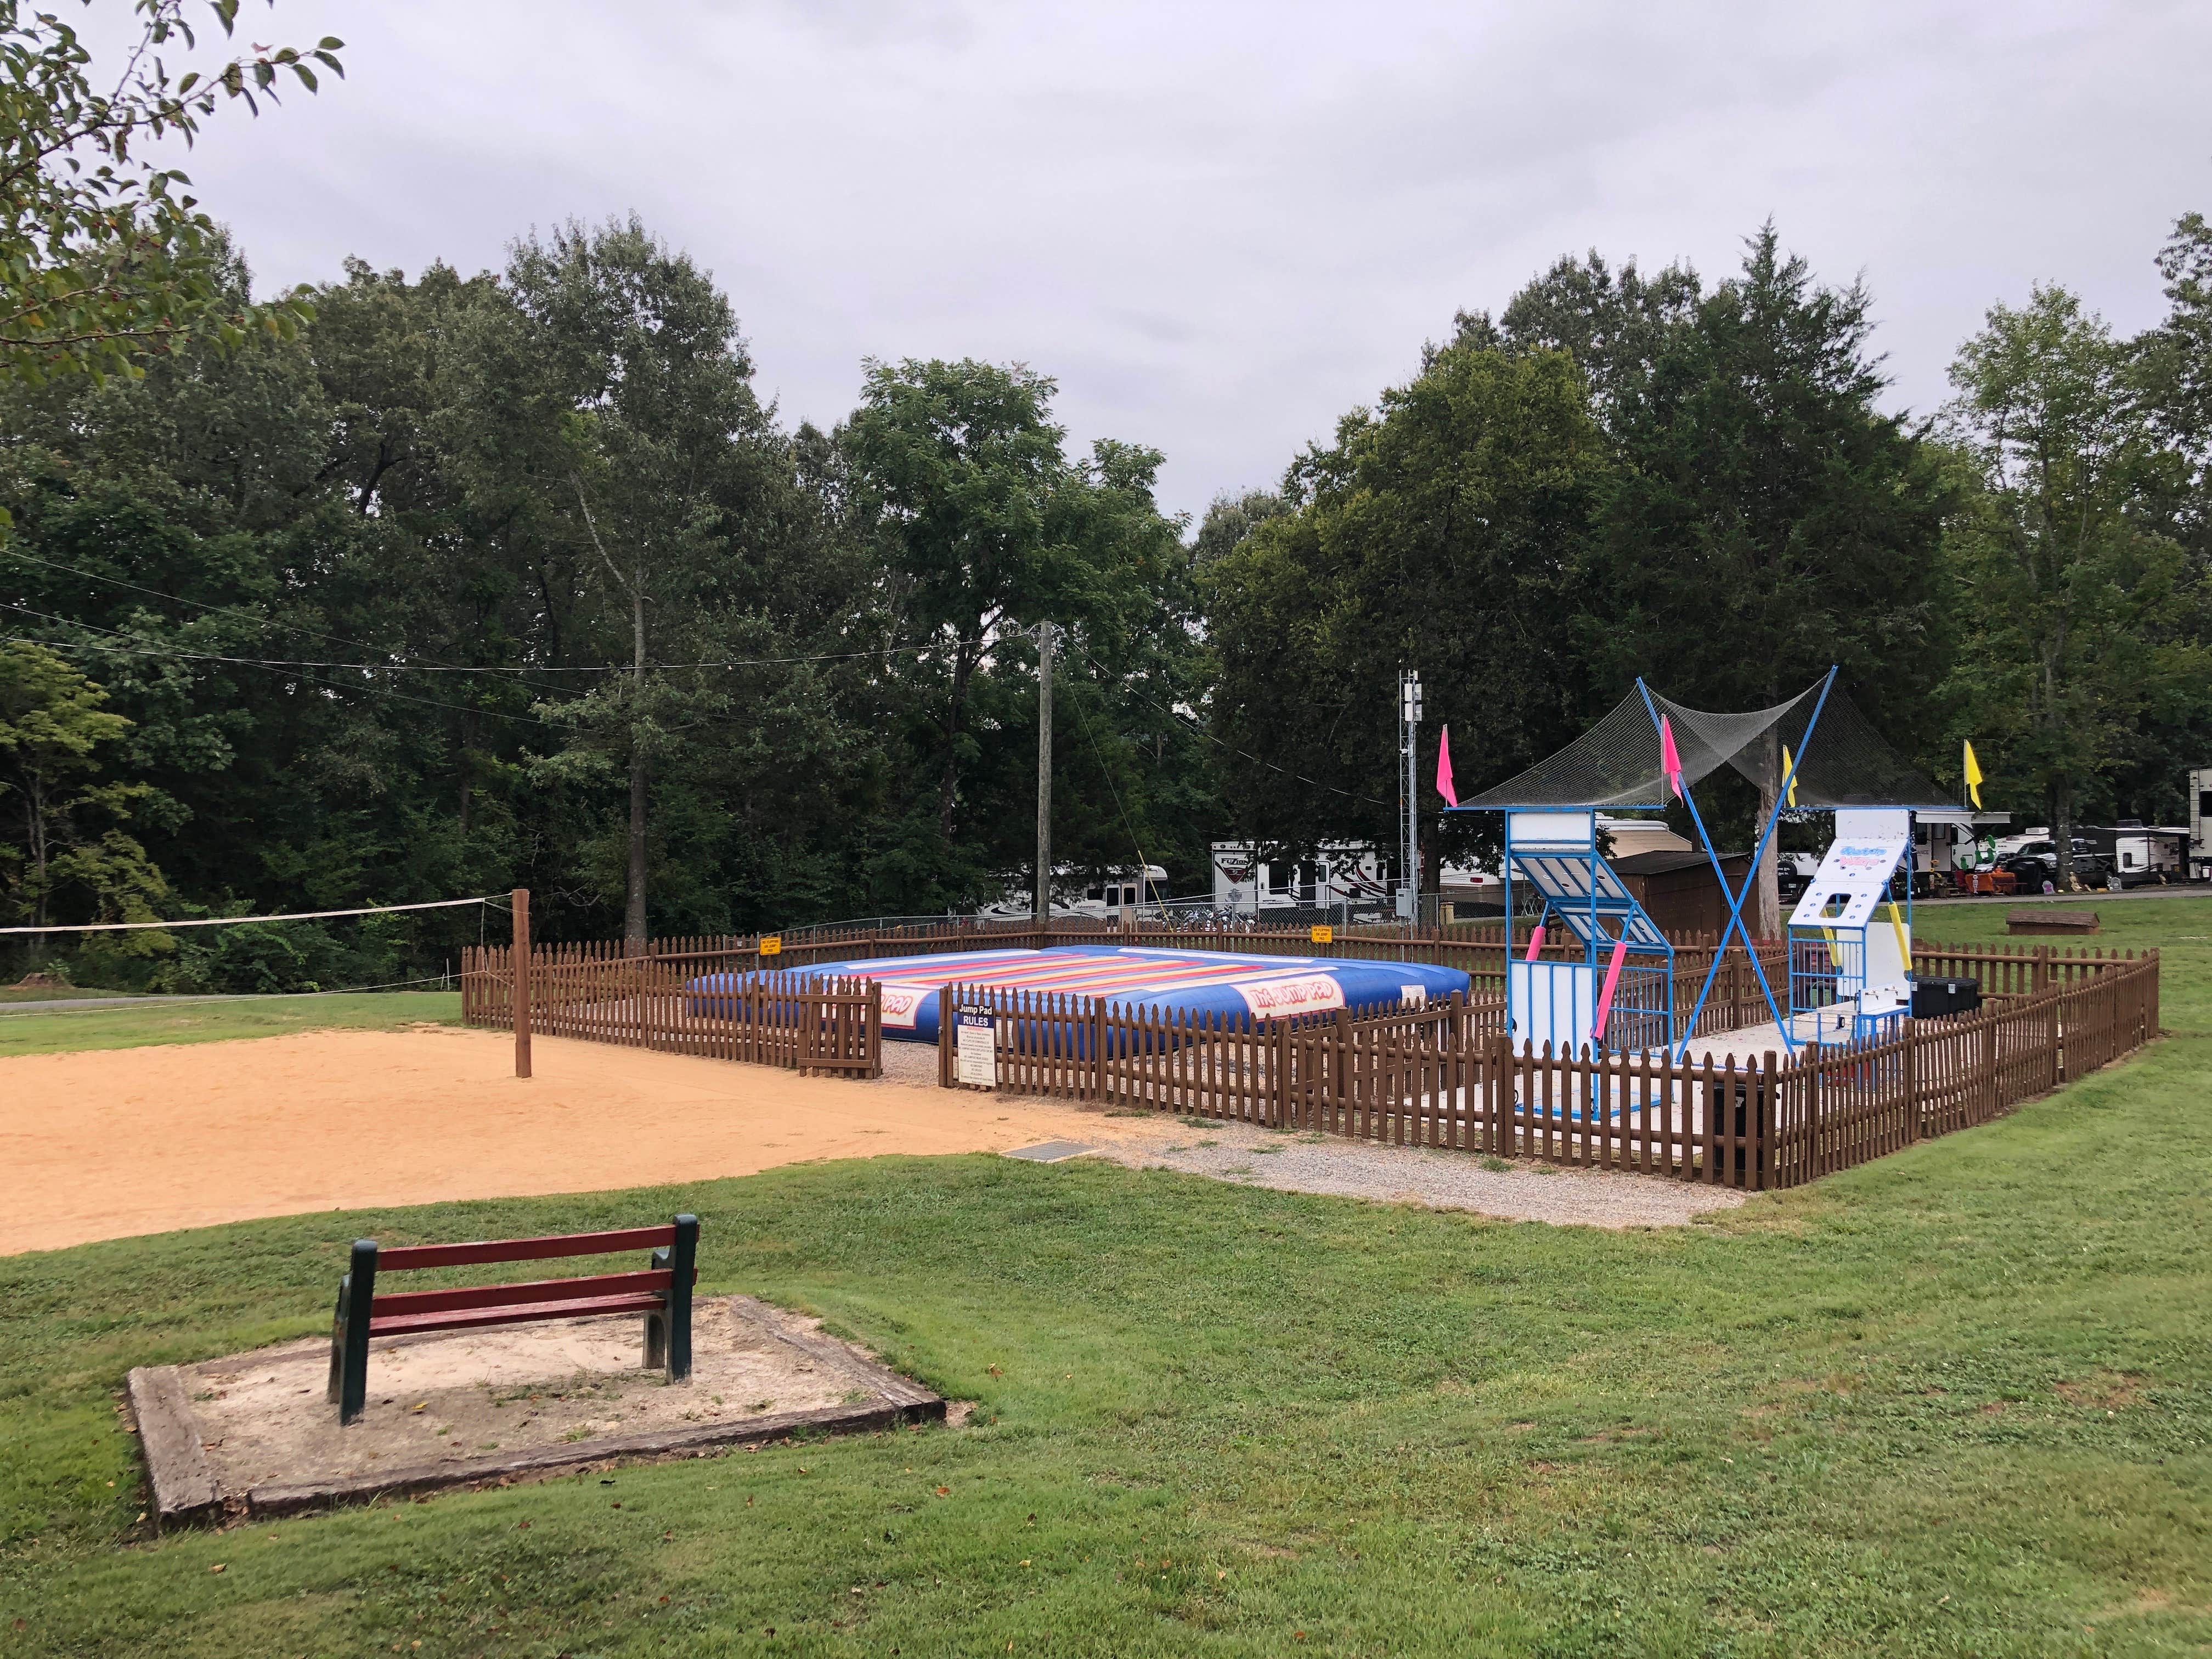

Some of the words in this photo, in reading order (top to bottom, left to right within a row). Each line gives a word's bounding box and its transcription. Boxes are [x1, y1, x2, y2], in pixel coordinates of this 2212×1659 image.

[1305, 981, 1333, 1000] PAD
[882, 995, 913, 1014] PAD
[959, 1004, 978, 1015] Jump
[979, 1006, 992, 1015] Pad
[963, 1015, 989, 1026] RULES
